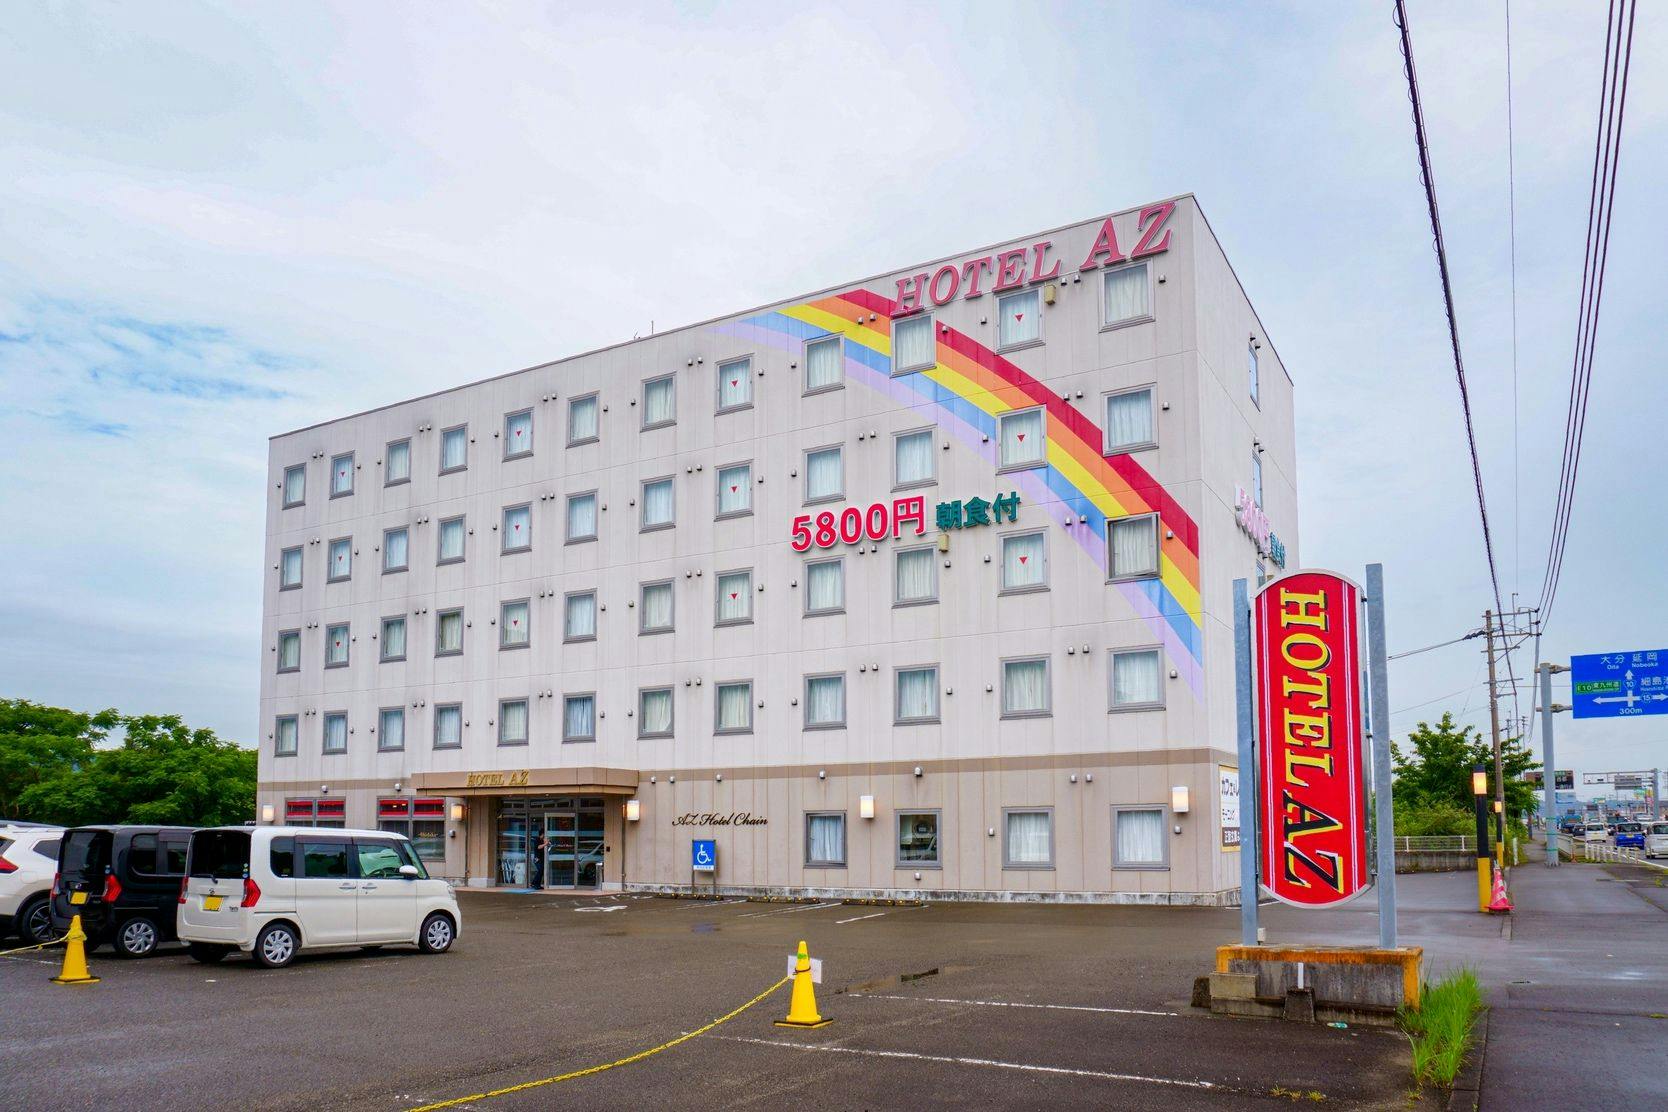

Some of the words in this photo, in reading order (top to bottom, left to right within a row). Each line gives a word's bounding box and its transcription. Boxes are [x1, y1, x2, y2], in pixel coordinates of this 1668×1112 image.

[890, 241, 1062, 317] HOTEL
[1079, 201, 1176, 271] AZ
[790, 494, 928, 552] 5800円
[935, 491, 1021, 530] 朝食付
[1279, 587, 1333, 788] HOTEL
[1600, 654, 1625, 664] 大分
[1632, 652, 1658, 662] 延岡
[466, 771, 505, 787] HOTEL
[508, 769, 529, 786] AZ
[672, 812, 699, 826] AZ
[700, 812, 735, 826] Hotel
[734, 812, 768, 826] Chain
[1283, 790, 1344, 894] AZ
